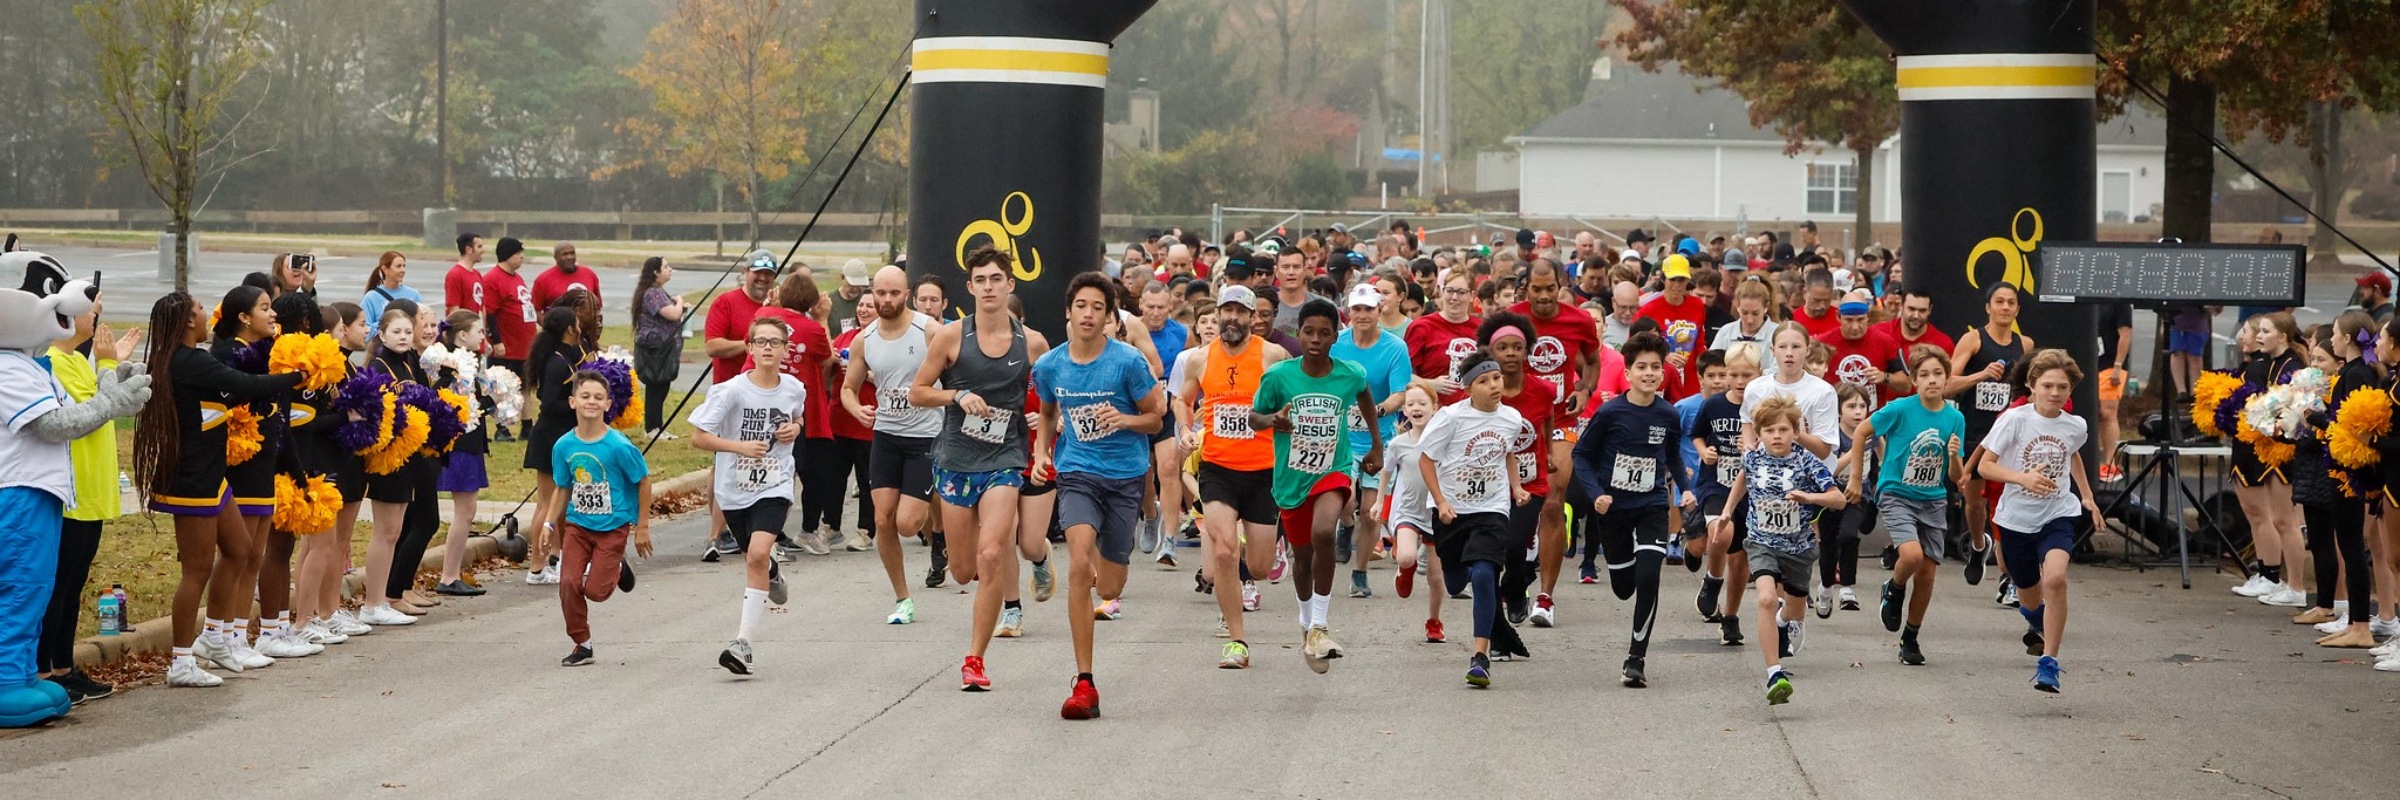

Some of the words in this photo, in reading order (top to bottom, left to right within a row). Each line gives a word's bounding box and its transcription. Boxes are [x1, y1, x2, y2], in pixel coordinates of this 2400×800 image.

[1055, 387, 1115, 399] Champion
[1982, 392, 2005, 406] 326
[1298, 398, 1337, 410] RELISH
[743, 408, 767, 419] DMS
[1297, 415, 1335, 425] SWEET
[741, 419, 765, 431] RUN
[980, 418, 992, 433] 3
[1078, 417, 1102, 434] 32
[1220, 416, 1247, 432] 358
[1294, 424, 1337, 438] JESUS
[1298, 450, 1326, 467] 227
[748, 469, 768, 485] 42
[1518, 465, 1528, 478] 5
[1627, 469, 1643, 484] 14
[1725, 468, 1740, 481] 19
[1913, 467, 1936, 481] 180
[1467, 480, 1486, 495] 34
[577, 493, 604, 508] 333
[1765, 511, 1791, 528] 201
